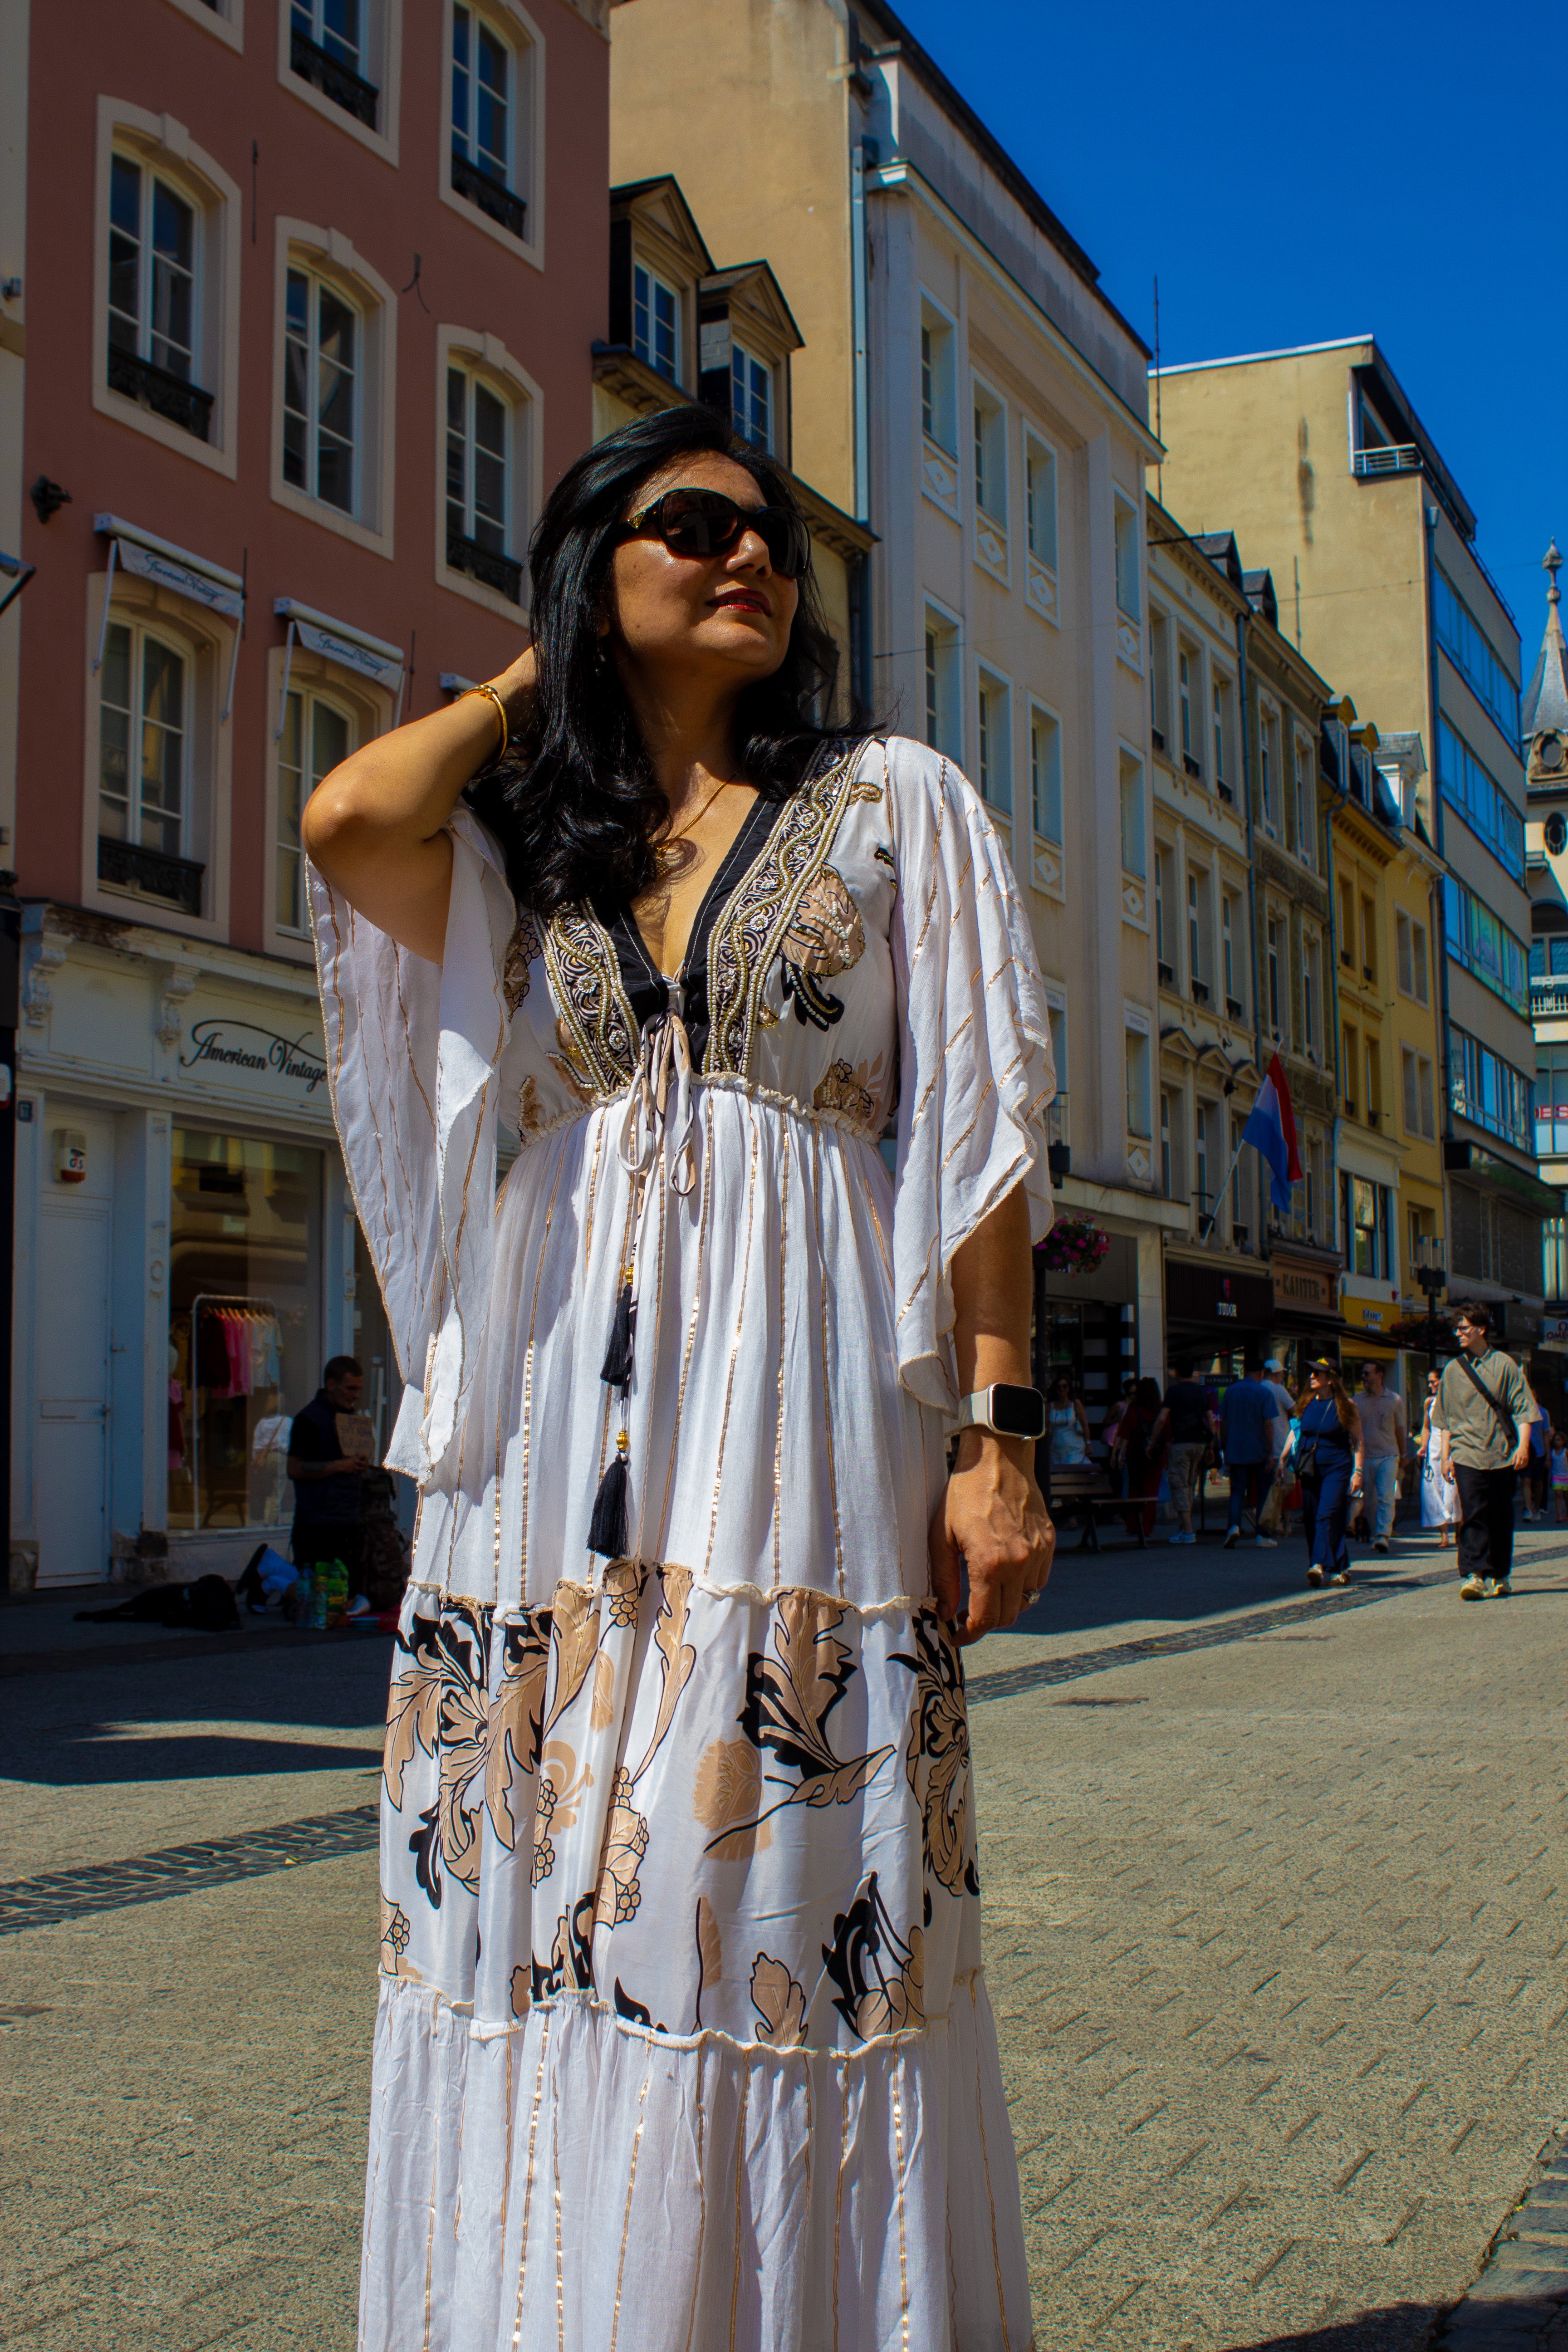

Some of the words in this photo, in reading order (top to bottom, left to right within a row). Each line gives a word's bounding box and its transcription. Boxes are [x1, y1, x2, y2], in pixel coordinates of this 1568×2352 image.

[180, 1020, 267, 1070] American
[268, 1031, 328, 1093] Vintage
[1534, 1105, 1568, 1120] ES
[1216, 1302, 1237, 1317] TUDOR
